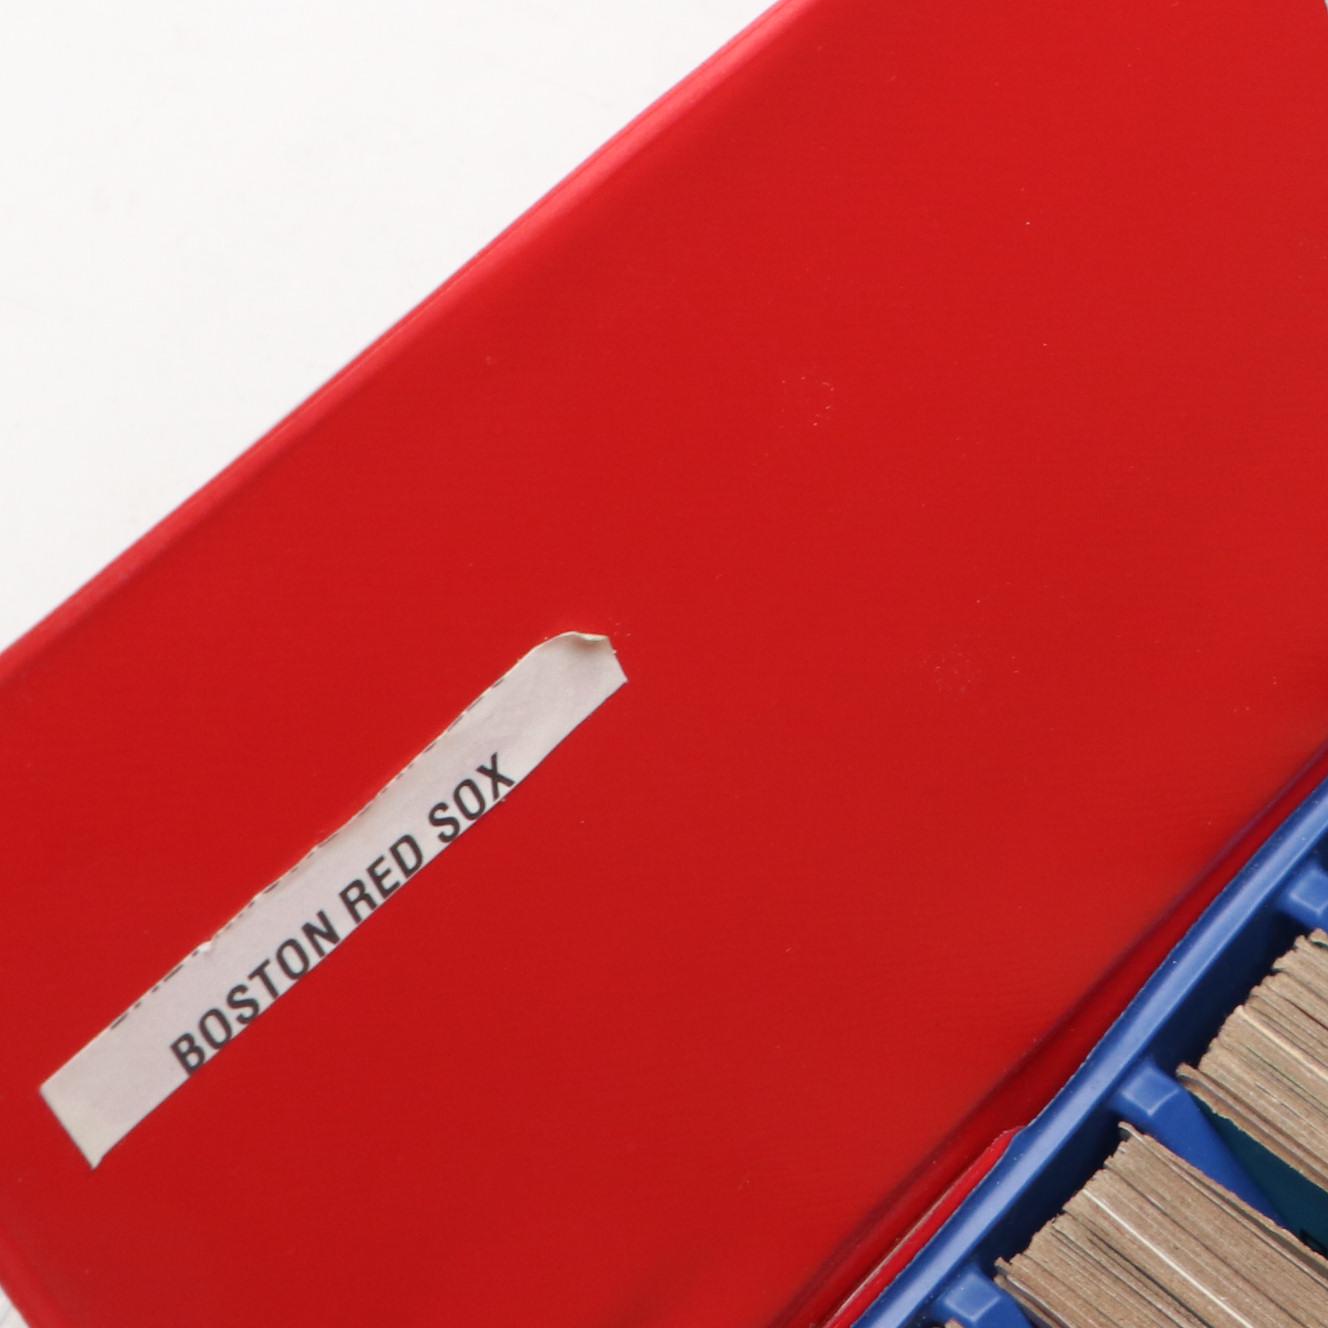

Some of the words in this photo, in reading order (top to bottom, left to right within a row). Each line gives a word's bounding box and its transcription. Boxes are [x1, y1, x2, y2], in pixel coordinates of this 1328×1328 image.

[170, 910, 340, 1076] BOSTON
[340, 834, 423, 923] RED
[428, 753, 515, 844] SOX
